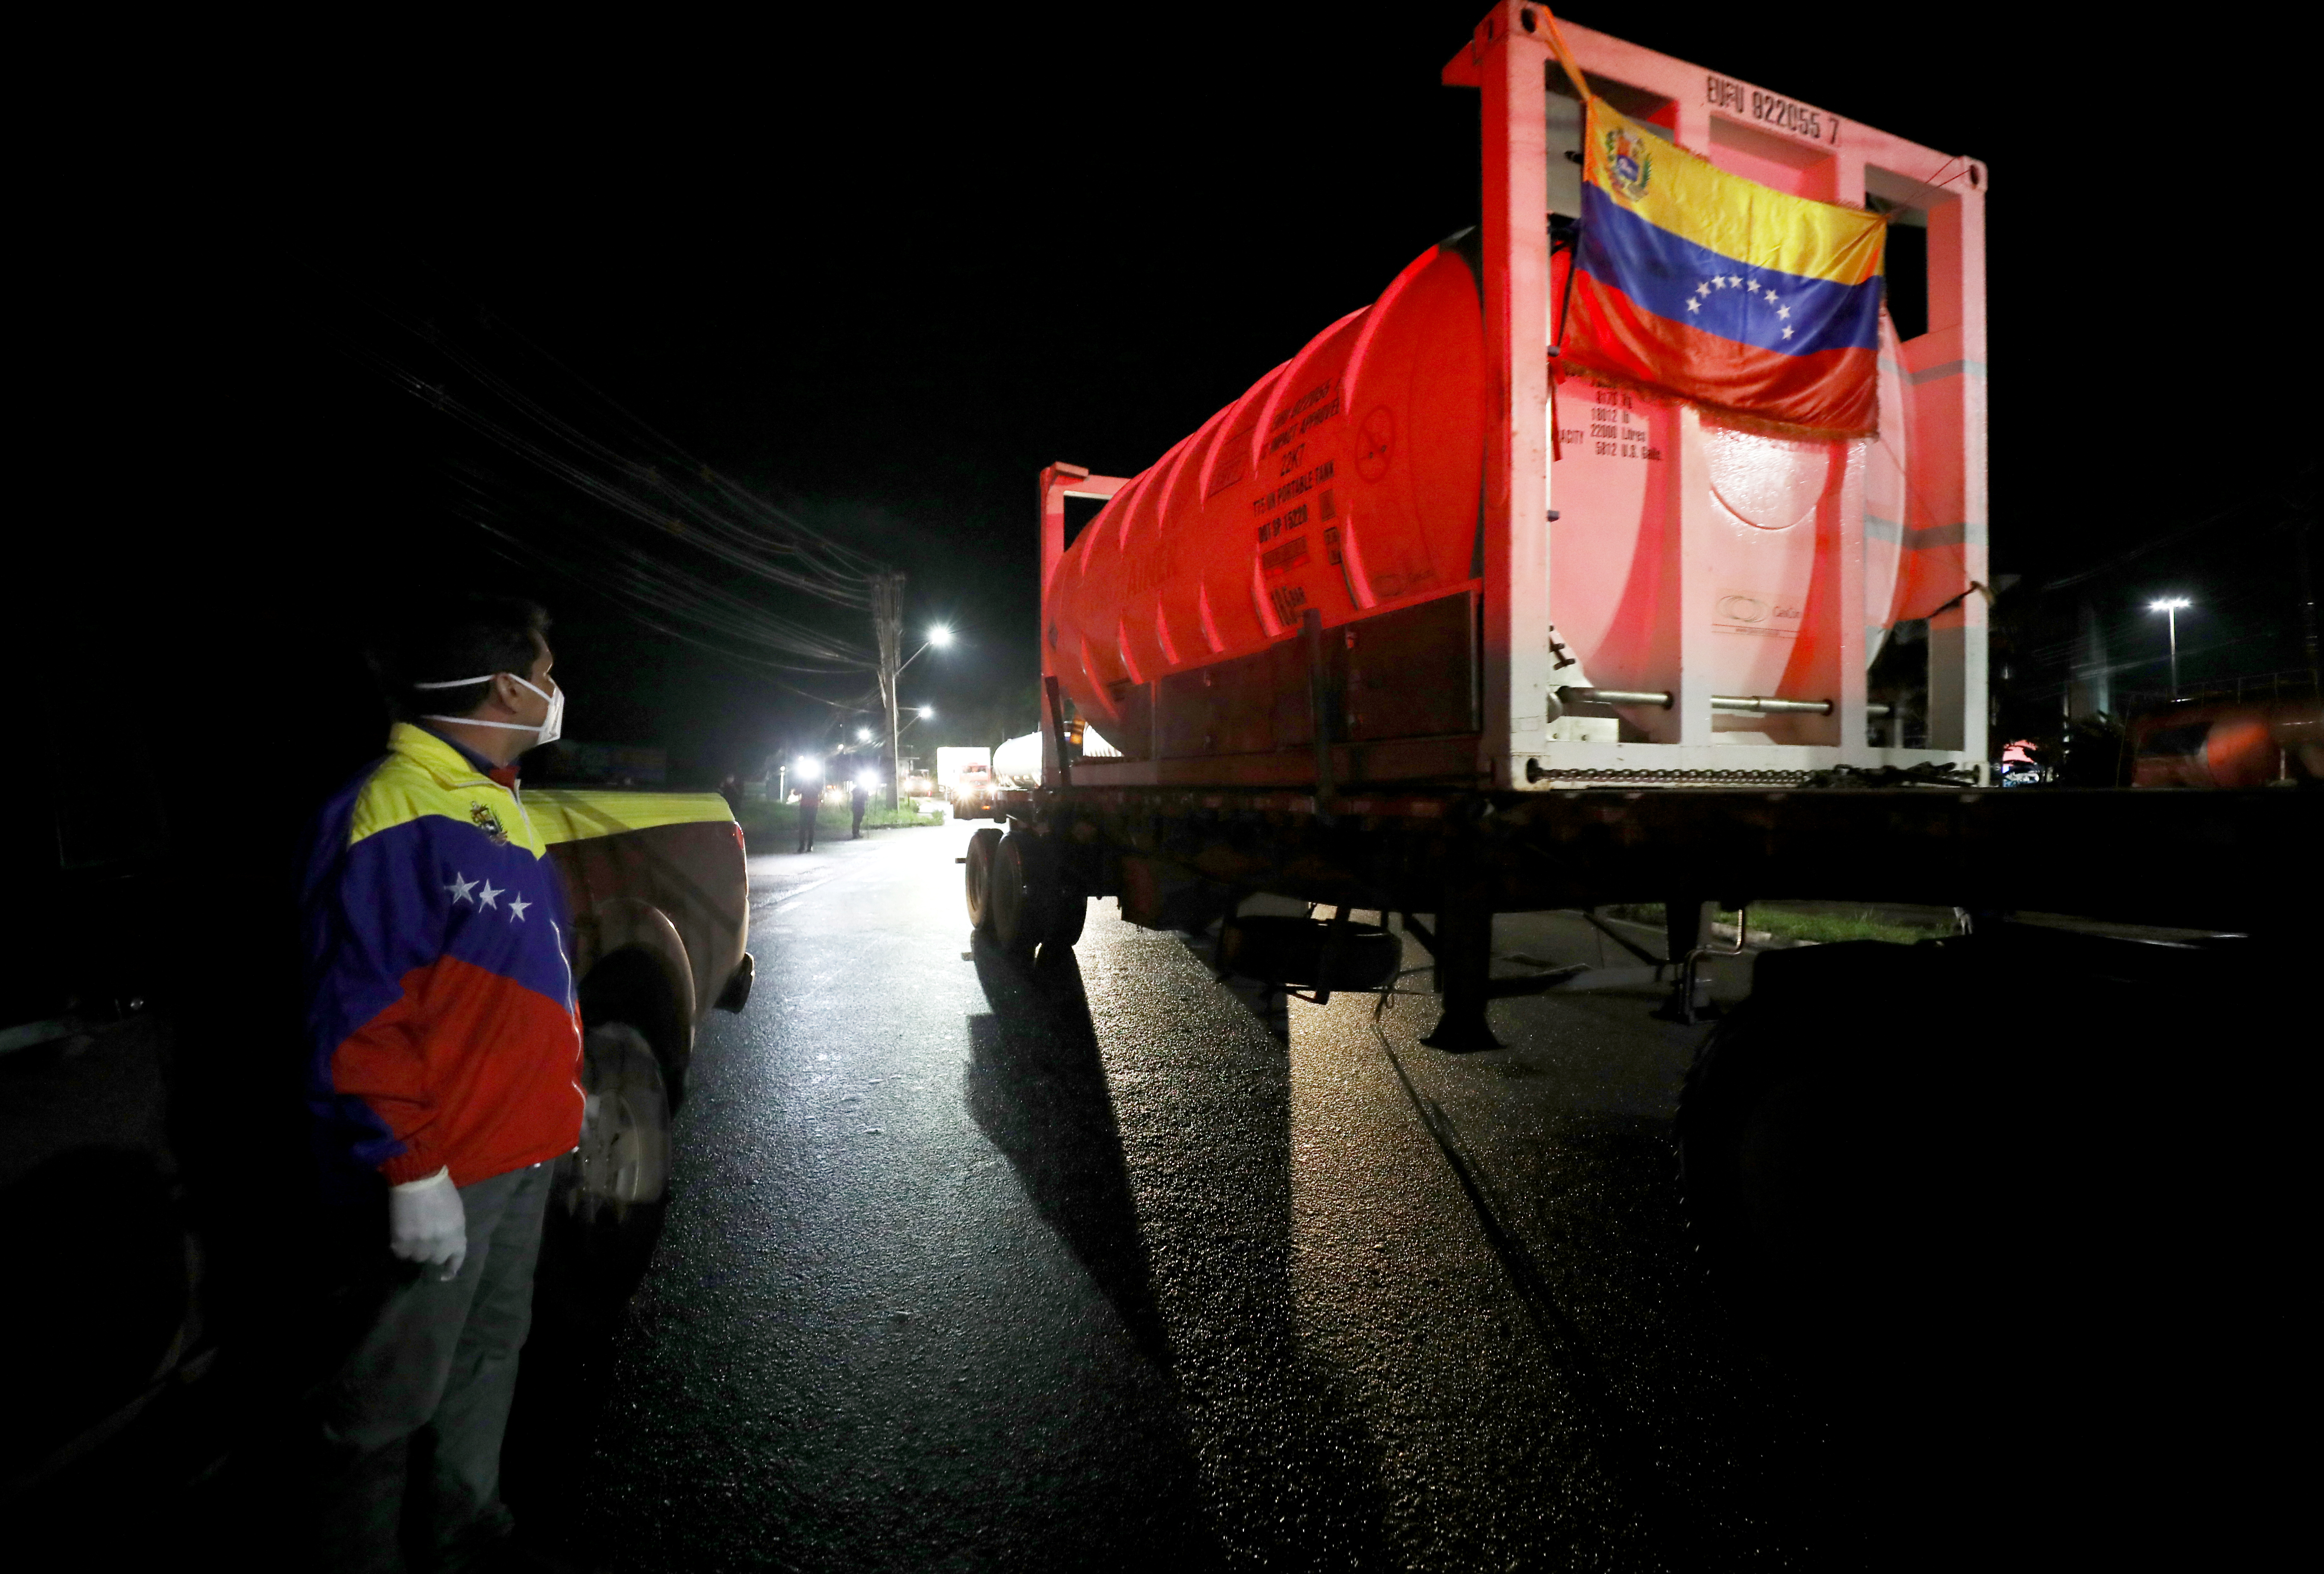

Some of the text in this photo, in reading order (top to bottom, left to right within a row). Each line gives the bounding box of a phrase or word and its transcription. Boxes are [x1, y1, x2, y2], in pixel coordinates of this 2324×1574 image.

[1753, 91, 1821, 139] 822055
[1829, 117, 1839, 145] 7
[1558, 430, 1584, 444] ACITY
[1590, 423, 1618, 438] 22000
[1277, 471, 1313, 506] PORTABLE
[1315, 459, 1334, 484] TANK
